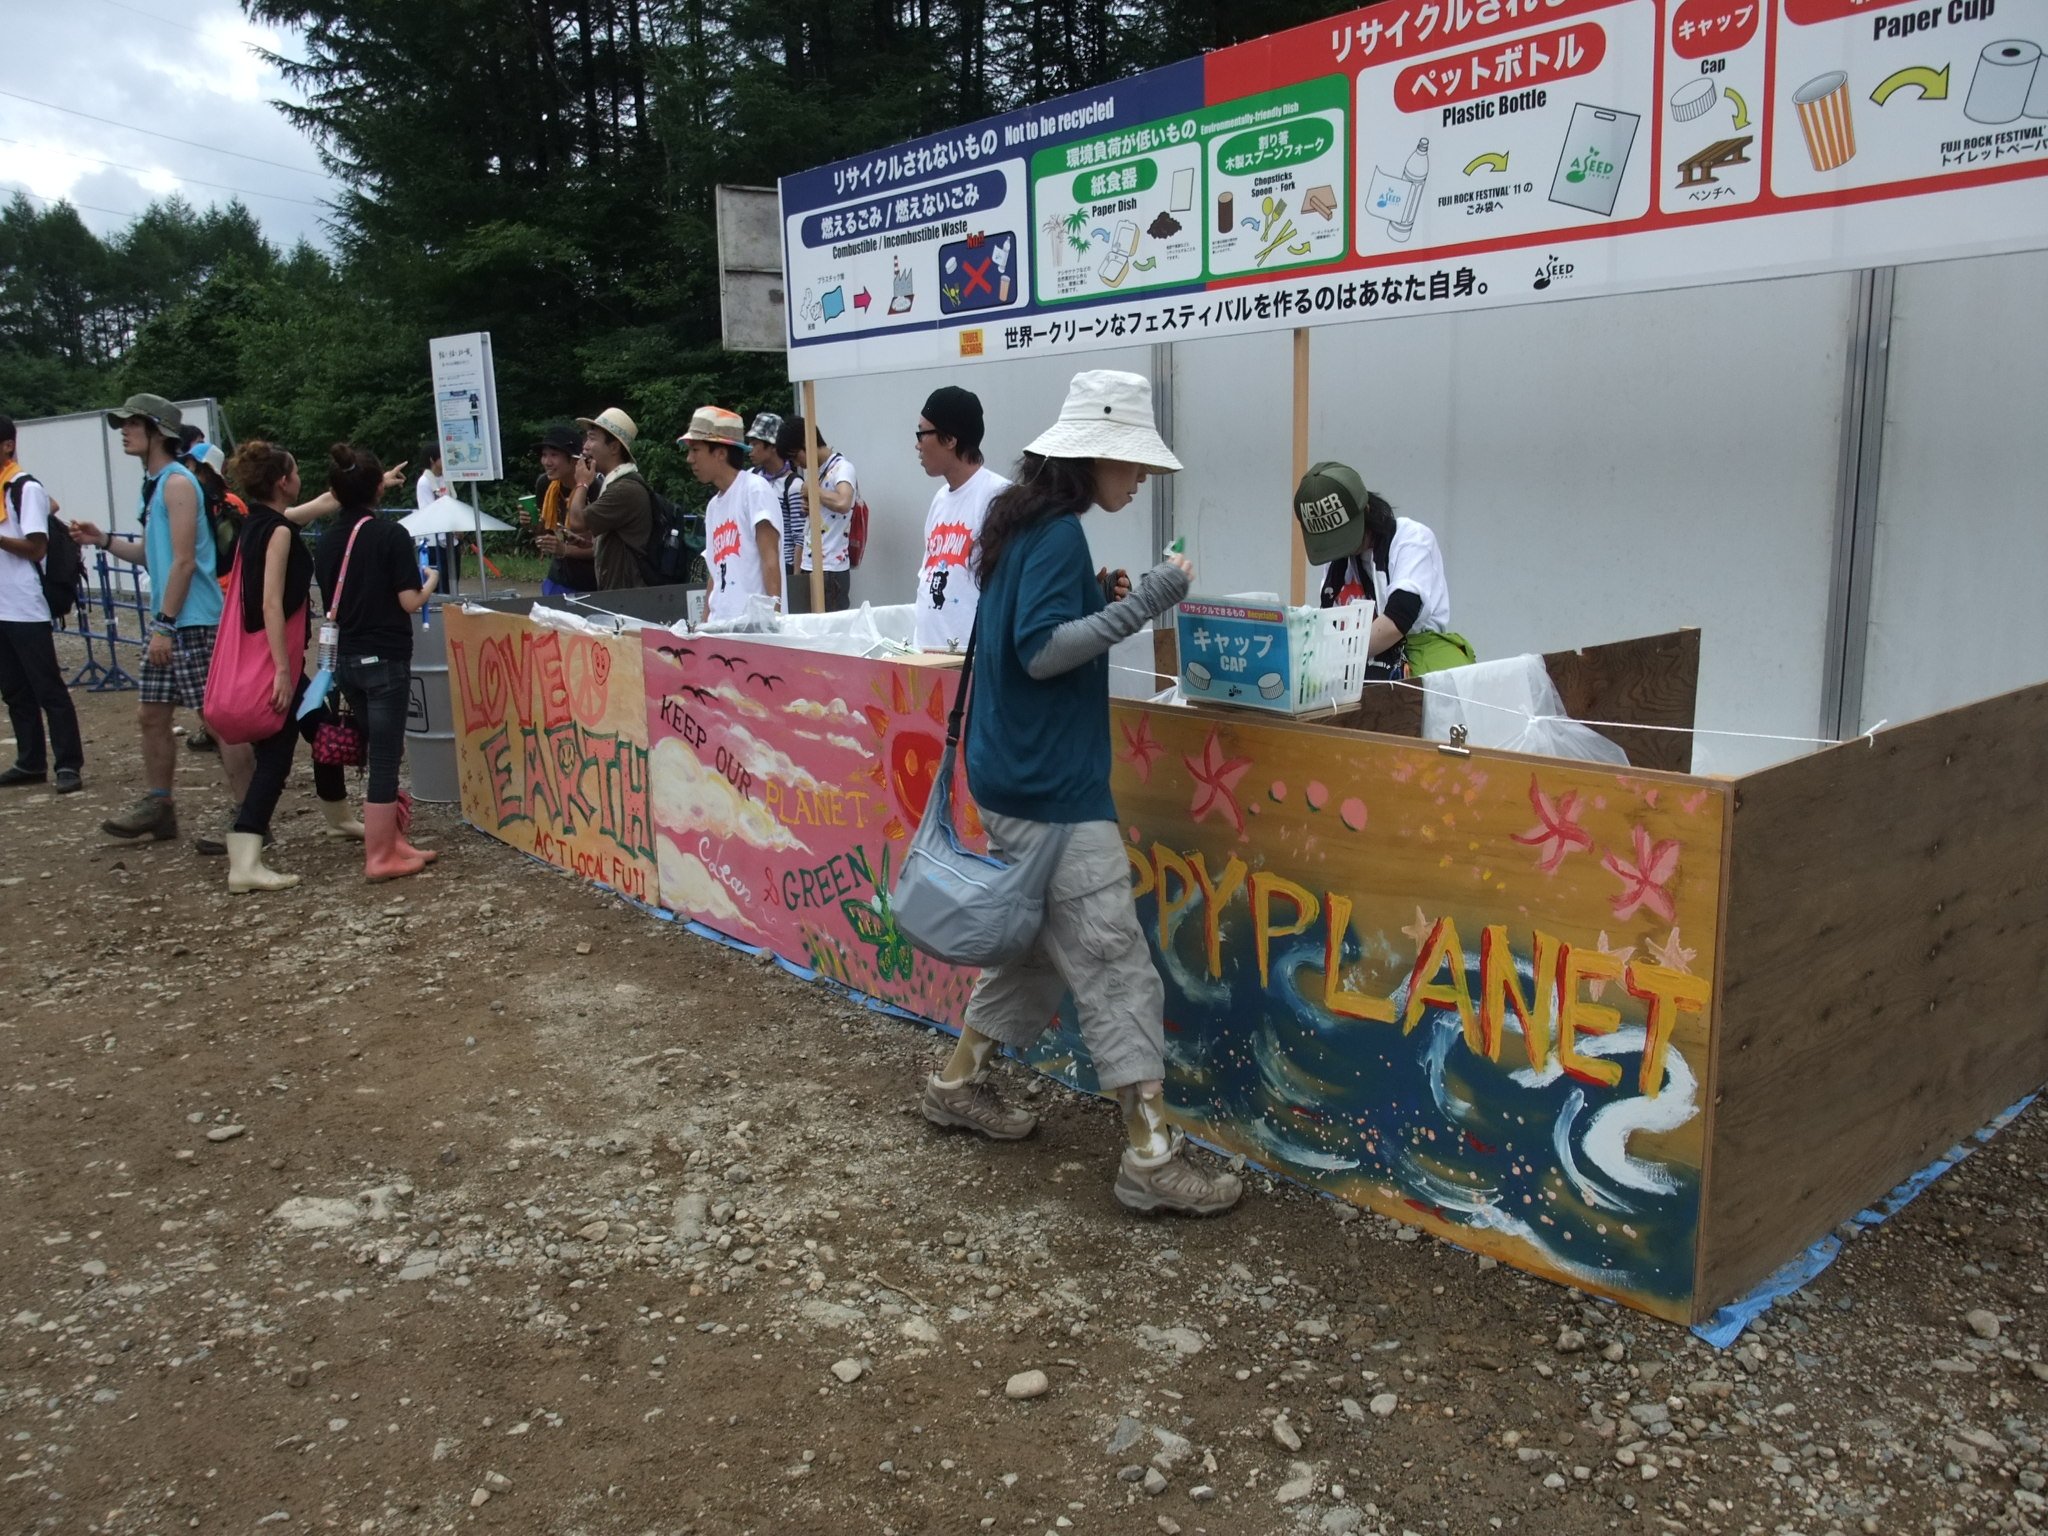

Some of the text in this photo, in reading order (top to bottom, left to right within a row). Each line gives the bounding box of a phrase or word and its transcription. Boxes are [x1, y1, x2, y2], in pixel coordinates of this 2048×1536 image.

[1332, 0, 1567, 63] リサイクルされ
[1677, 4, 1754, 42] キャップ
[1873, 0, 1996, 41] Paper Cup
[1411, 33, 1585, 97] ペットボトル
[1700, 56, 1726, 76] Cap
[1442, 89, 1547, 128] Plastic Bottle
[834, 96, 1115, 195] リサイクルされないもの Not to be recycled
[1066, 119, 1197, 168] 環境負荷が低いもの
[1225, 136, 1325, 171] 木製スプーンフォーク
[1258, 130, 1289, 151] 割り箸
[1940, 141, 1961, 154] FUJI
[1963, 134, 1993, 150] ROCK
[1090, 166, 1137, 197] 紙食器
[1251, 181, 1296, 198] Spoon Fork
[1254, 172, 1293, 187] Chopsticks
[821, 207, 882, 240] 燃えるごみ
[895, 183, 980, 223] 燃えないごみ
[1092, 197, 1137, 217] Paper Dish
[1438, 194, 1453, 208] FUJI
[1454, 191, 1474, 205] ROCK
[832, 236, 877, 260] Combustible
[884, 224, 940, 249] Incombustible
[941, 219, 967, 238] Waste
[1005, 265, 1488, 350] 世界一クリーンなフェスティバルを作るのはあなた自身。
[1300, 492, 1343, 519] NEVER
[1306, 511, 1343, 533] MIND
[1183, 603, 1246, 619] リサイクルできるもの
[1193, 627, 1274, 658] キャップ
[450, 629, 573, 736] LOVE
[1220, 655, 1247, 673] CAP
[660, 694, 708, 749] KEEP
[480, 719, 657, 864] EARTH
[715, 746, 752, 801] OUR
[764, 781, 870, 828] PLANET
[534, 826, 567, 866] ACT
[570, 845, 610, 883] LOCAL
[783, 844, 873, 911] GREEN
